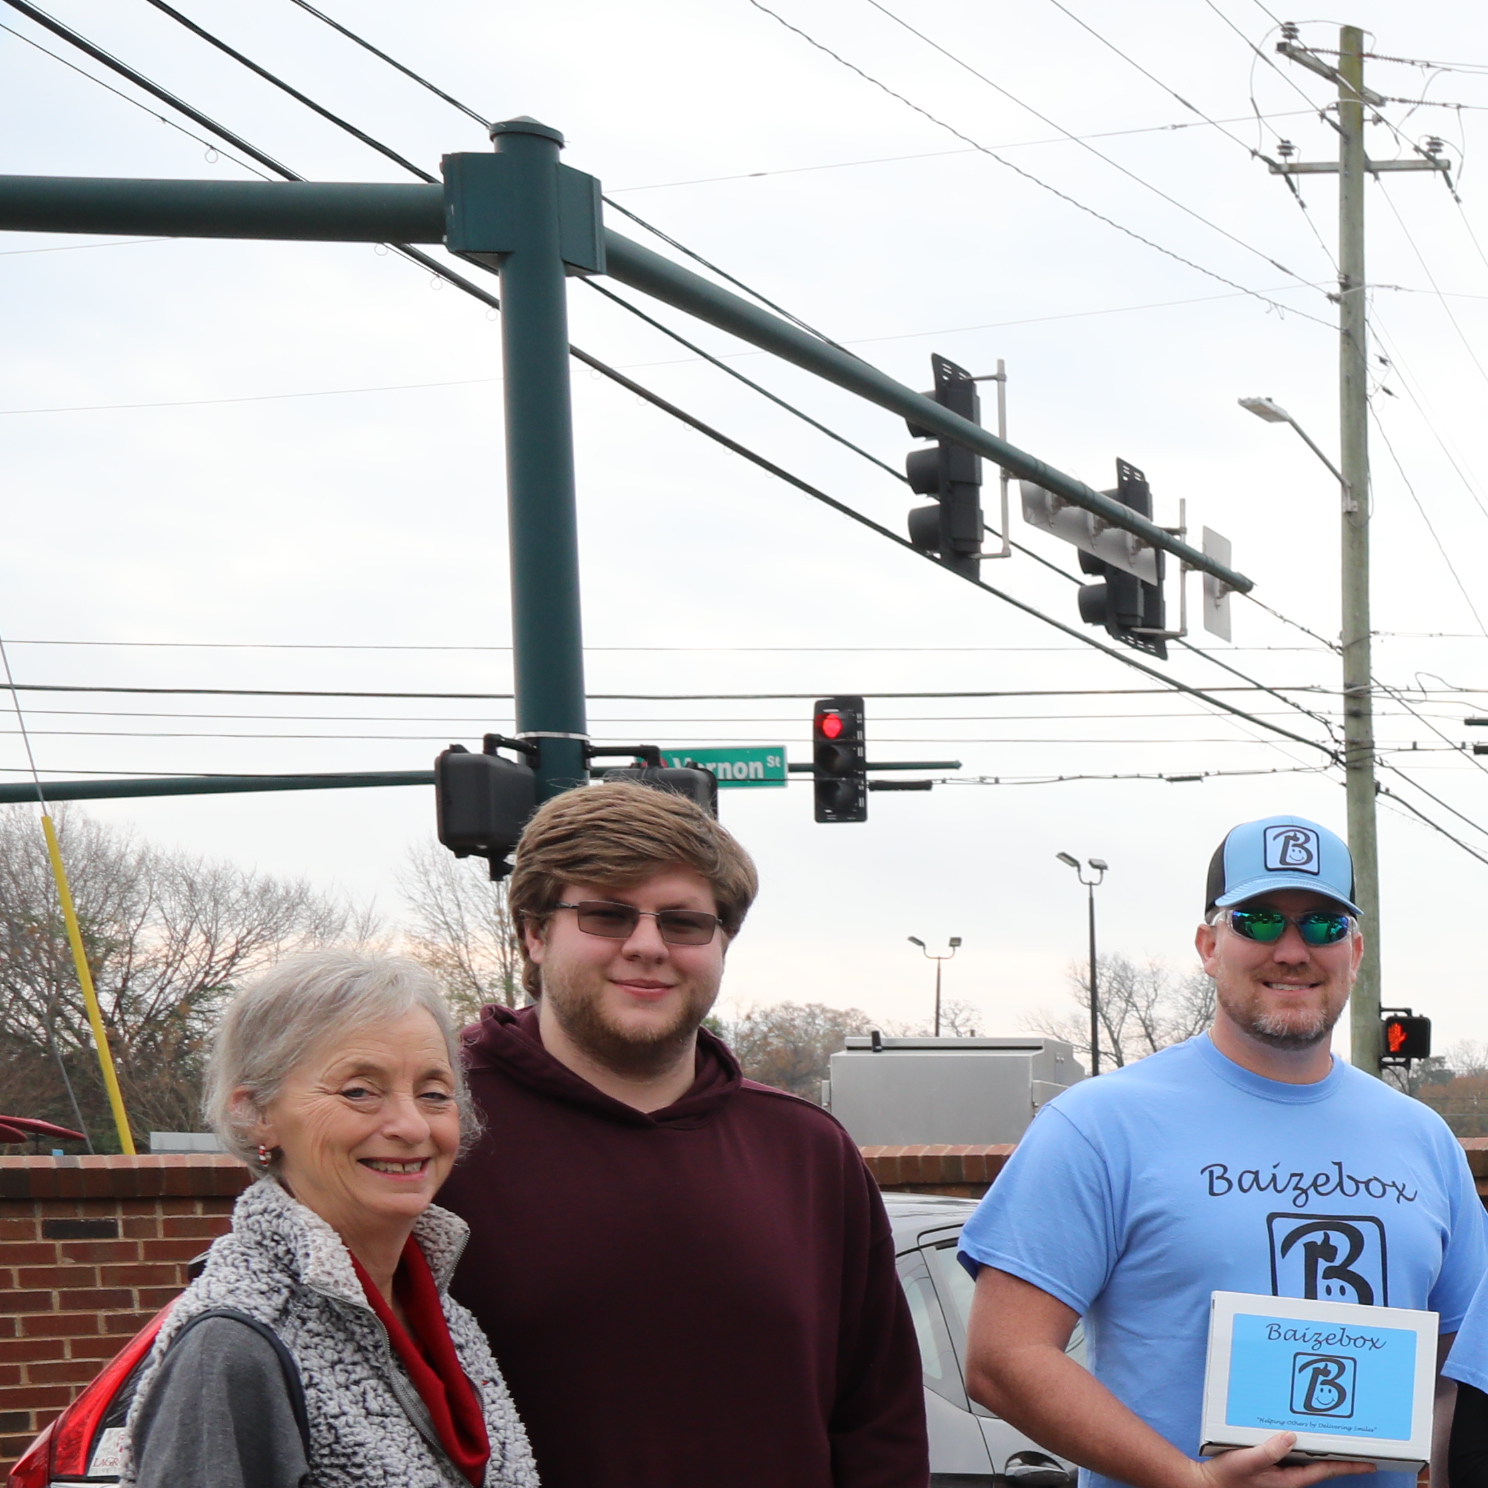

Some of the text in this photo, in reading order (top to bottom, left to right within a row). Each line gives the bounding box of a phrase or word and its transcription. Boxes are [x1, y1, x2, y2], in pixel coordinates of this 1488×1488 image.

[672, 755, 781, 780] Vrnon St
[1200, 1160, 1418, 1208] Baizebox
[1265, 1323, 1387, 1351] Baizebox
[92, 1456, 119, 1468] LAGR
